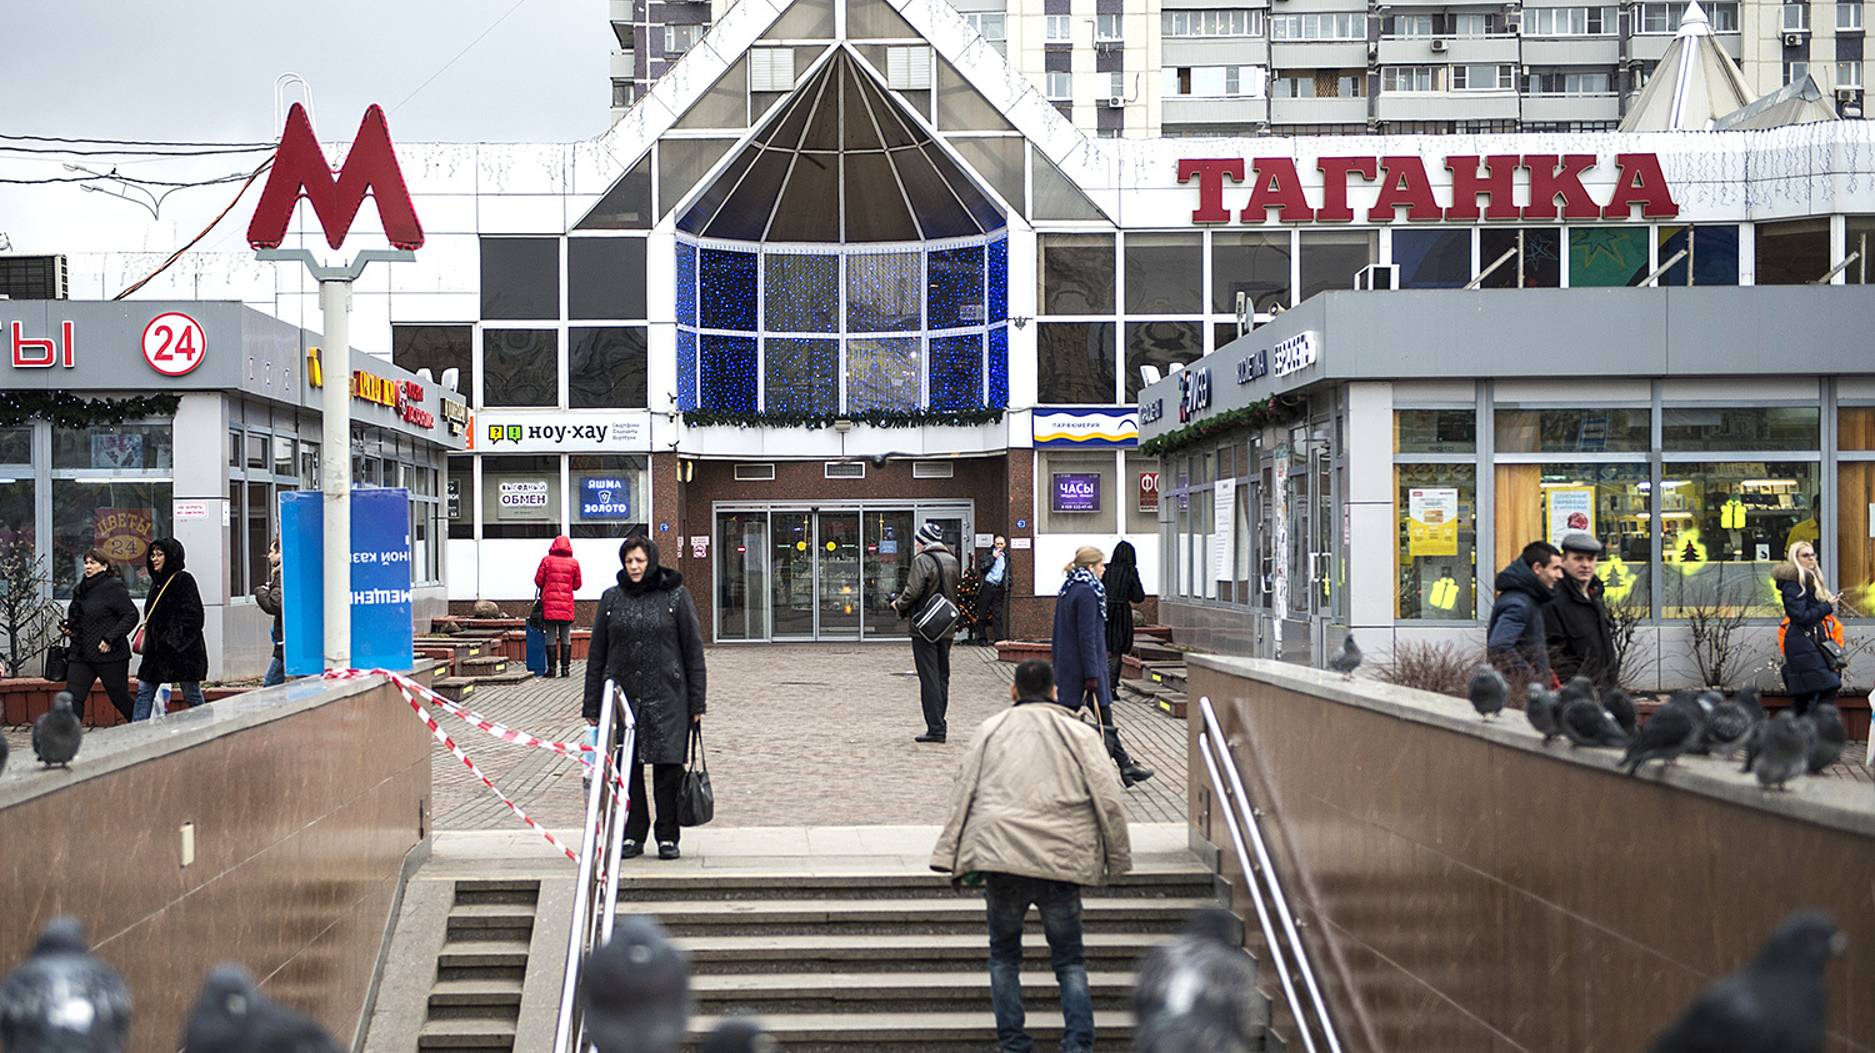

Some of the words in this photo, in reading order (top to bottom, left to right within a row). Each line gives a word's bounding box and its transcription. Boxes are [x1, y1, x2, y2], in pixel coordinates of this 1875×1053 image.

[247, 102, 424, 250] М
[1177, 153, 1679, 223] ТАГАНКА
[0, 320, 75, 368] Ы
[153, 325, 196, 361] 24
[588, 480, 622, 489] ЯШМА
[1060, 483, 1094, 494] ЧАСЫ
[502, 495, 546, 504] ОБМЕН
[584, 504, 627, 513] ЗОЛОТО
[111, 540, 138, 555] 24
[381, 551, 411, 567] ной
